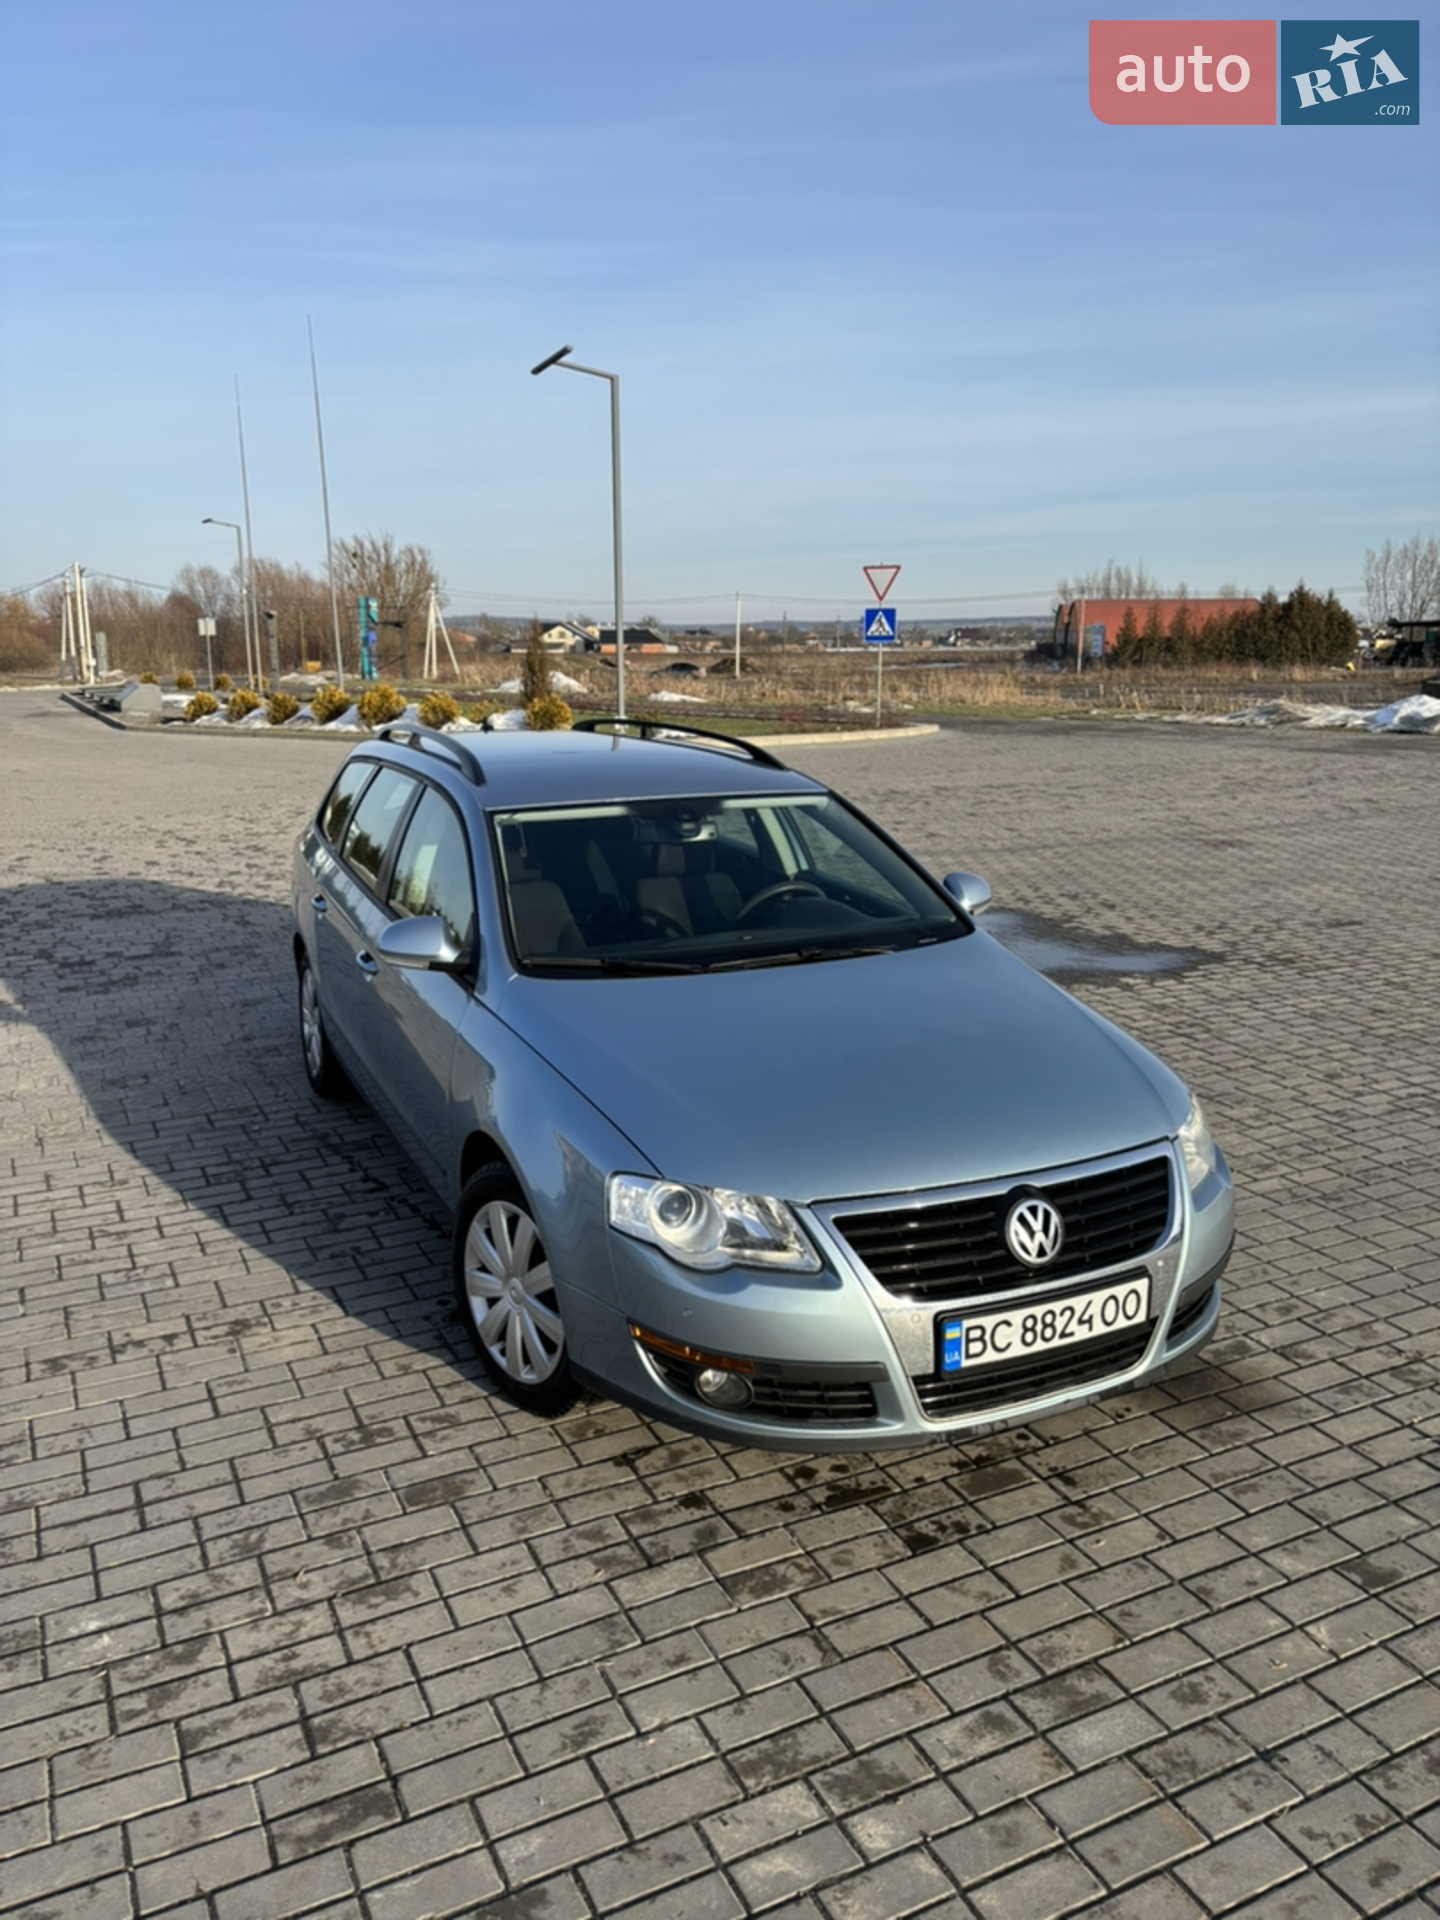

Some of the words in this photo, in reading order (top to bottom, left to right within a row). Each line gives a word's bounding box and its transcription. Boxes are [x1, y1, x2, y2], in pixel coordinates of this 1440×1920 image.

[964, 1320, 1013, 1360] BC
[1020, 1300, 1094, 1348] 8824
[944, 1351, 961, 1363] UA
